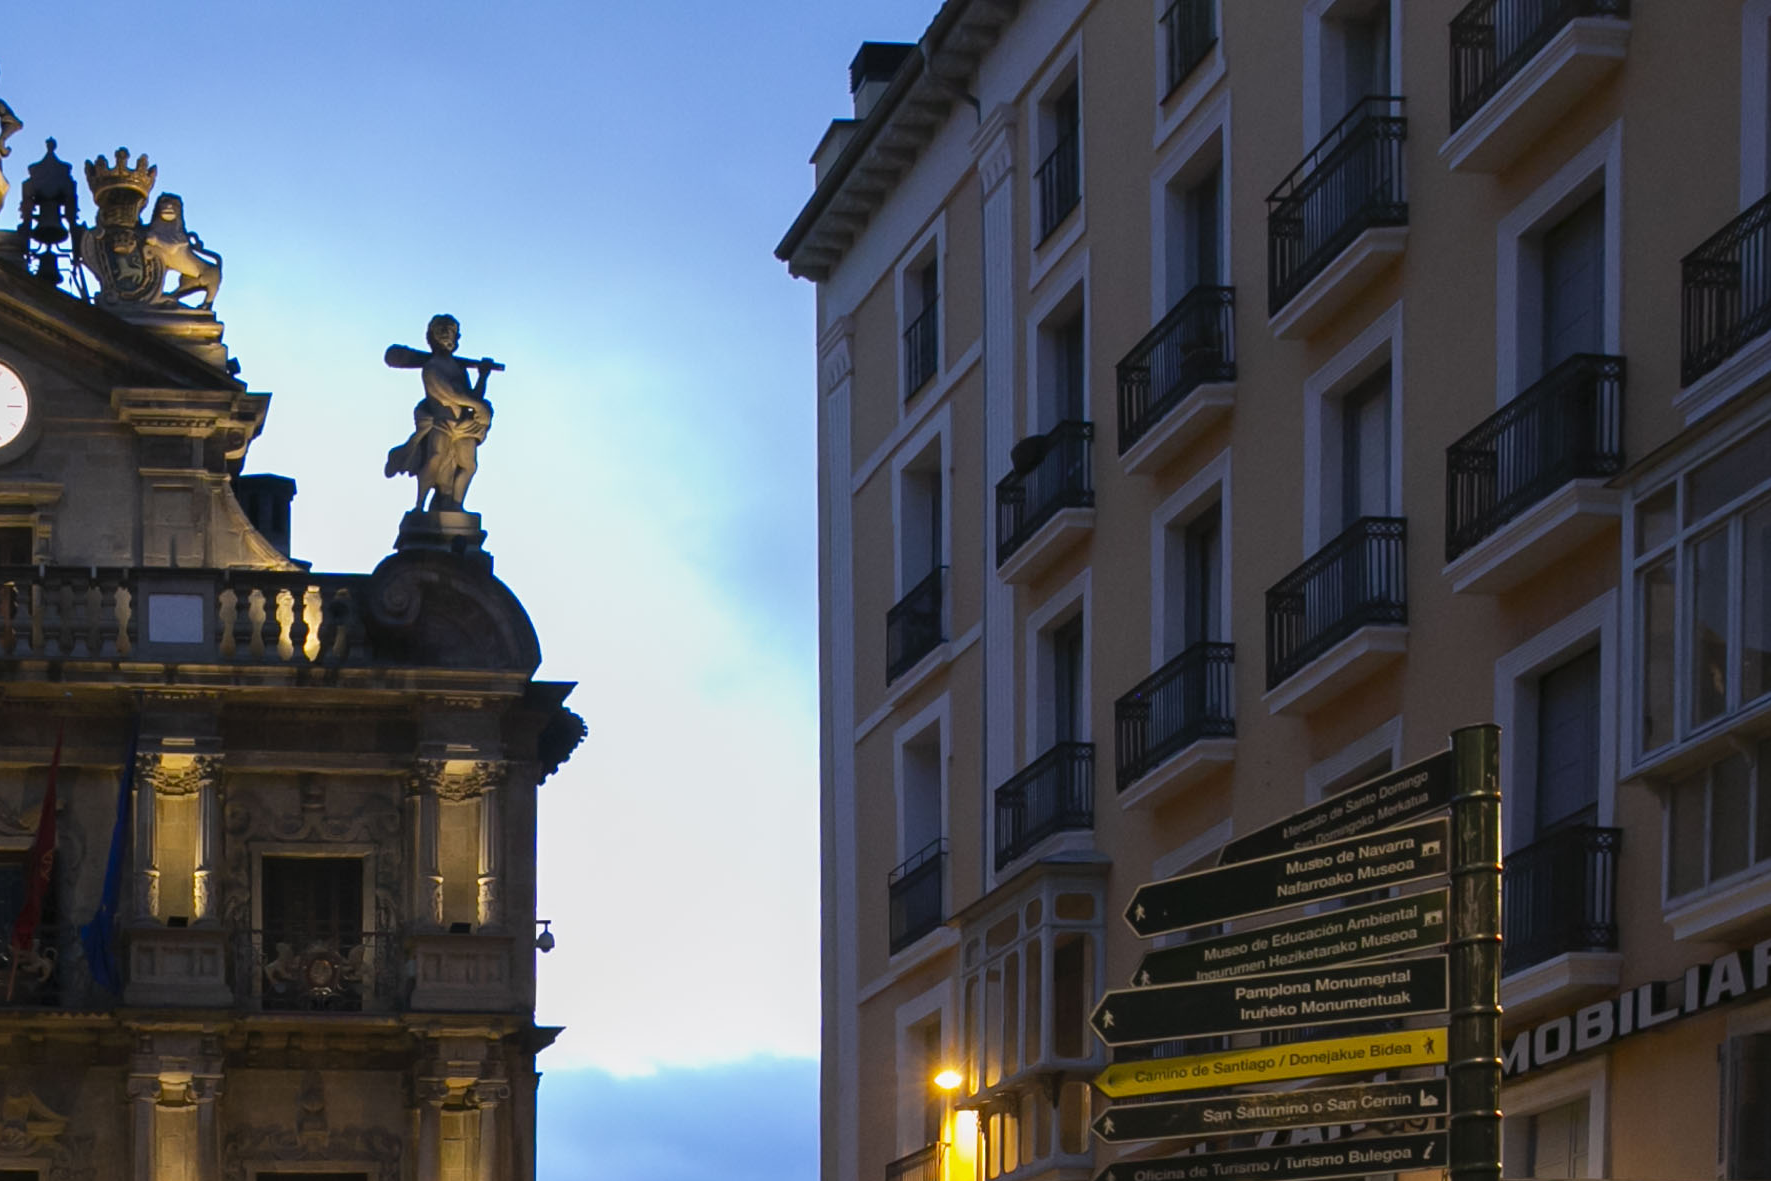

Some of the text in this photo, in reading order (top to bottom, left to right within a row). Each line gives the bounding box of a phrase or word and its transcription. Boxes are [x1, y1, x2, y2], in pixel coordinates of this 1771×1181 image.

[1283, 770, 1429, 840] Mercado de Santo Domingo
[1315, 813, 1375, 844] Domingoko
[1377, 791, 1429, 819] Merkatua
[1286, 836, 1415, 876] Museo de Navarra
[1277, 858, 1415, 898] Nafarroako Museoa
[1204, 905, 1418, 962] Museo de Educación Ambiental
[1196, 928, 1418, 981] Ingurumen Heziketarako Museoa
[1235, 969, 1411, 1001] Pamplona Monumental
[1240, 991, 1411, 1021] Iruñeko Monumentuak
[1135, 1066, 1188, 1083] Camino
[1191, 1063, 1210, 1078] de
[1213, 1054, 1275, 1076] Santiago
[1289, 1047, 1365, 1068] Donejakue
[1369, 1041, 1412, 1057] Bidea
[1203, 1108, 1232, 1123] San
[1312, 1101, 1323, 1113] o
[1327, 1097, 1357, 1112] San
[1361, 1091, 1412, 1109] Cernin
[1190, 1164, 1208, 1179] de
[1212, 1158, 1270, 1177] Turismo
[1285, 1152, 1344, 1170] Turismo
[1348, 1146, 1412, 1166] Bulegoa
